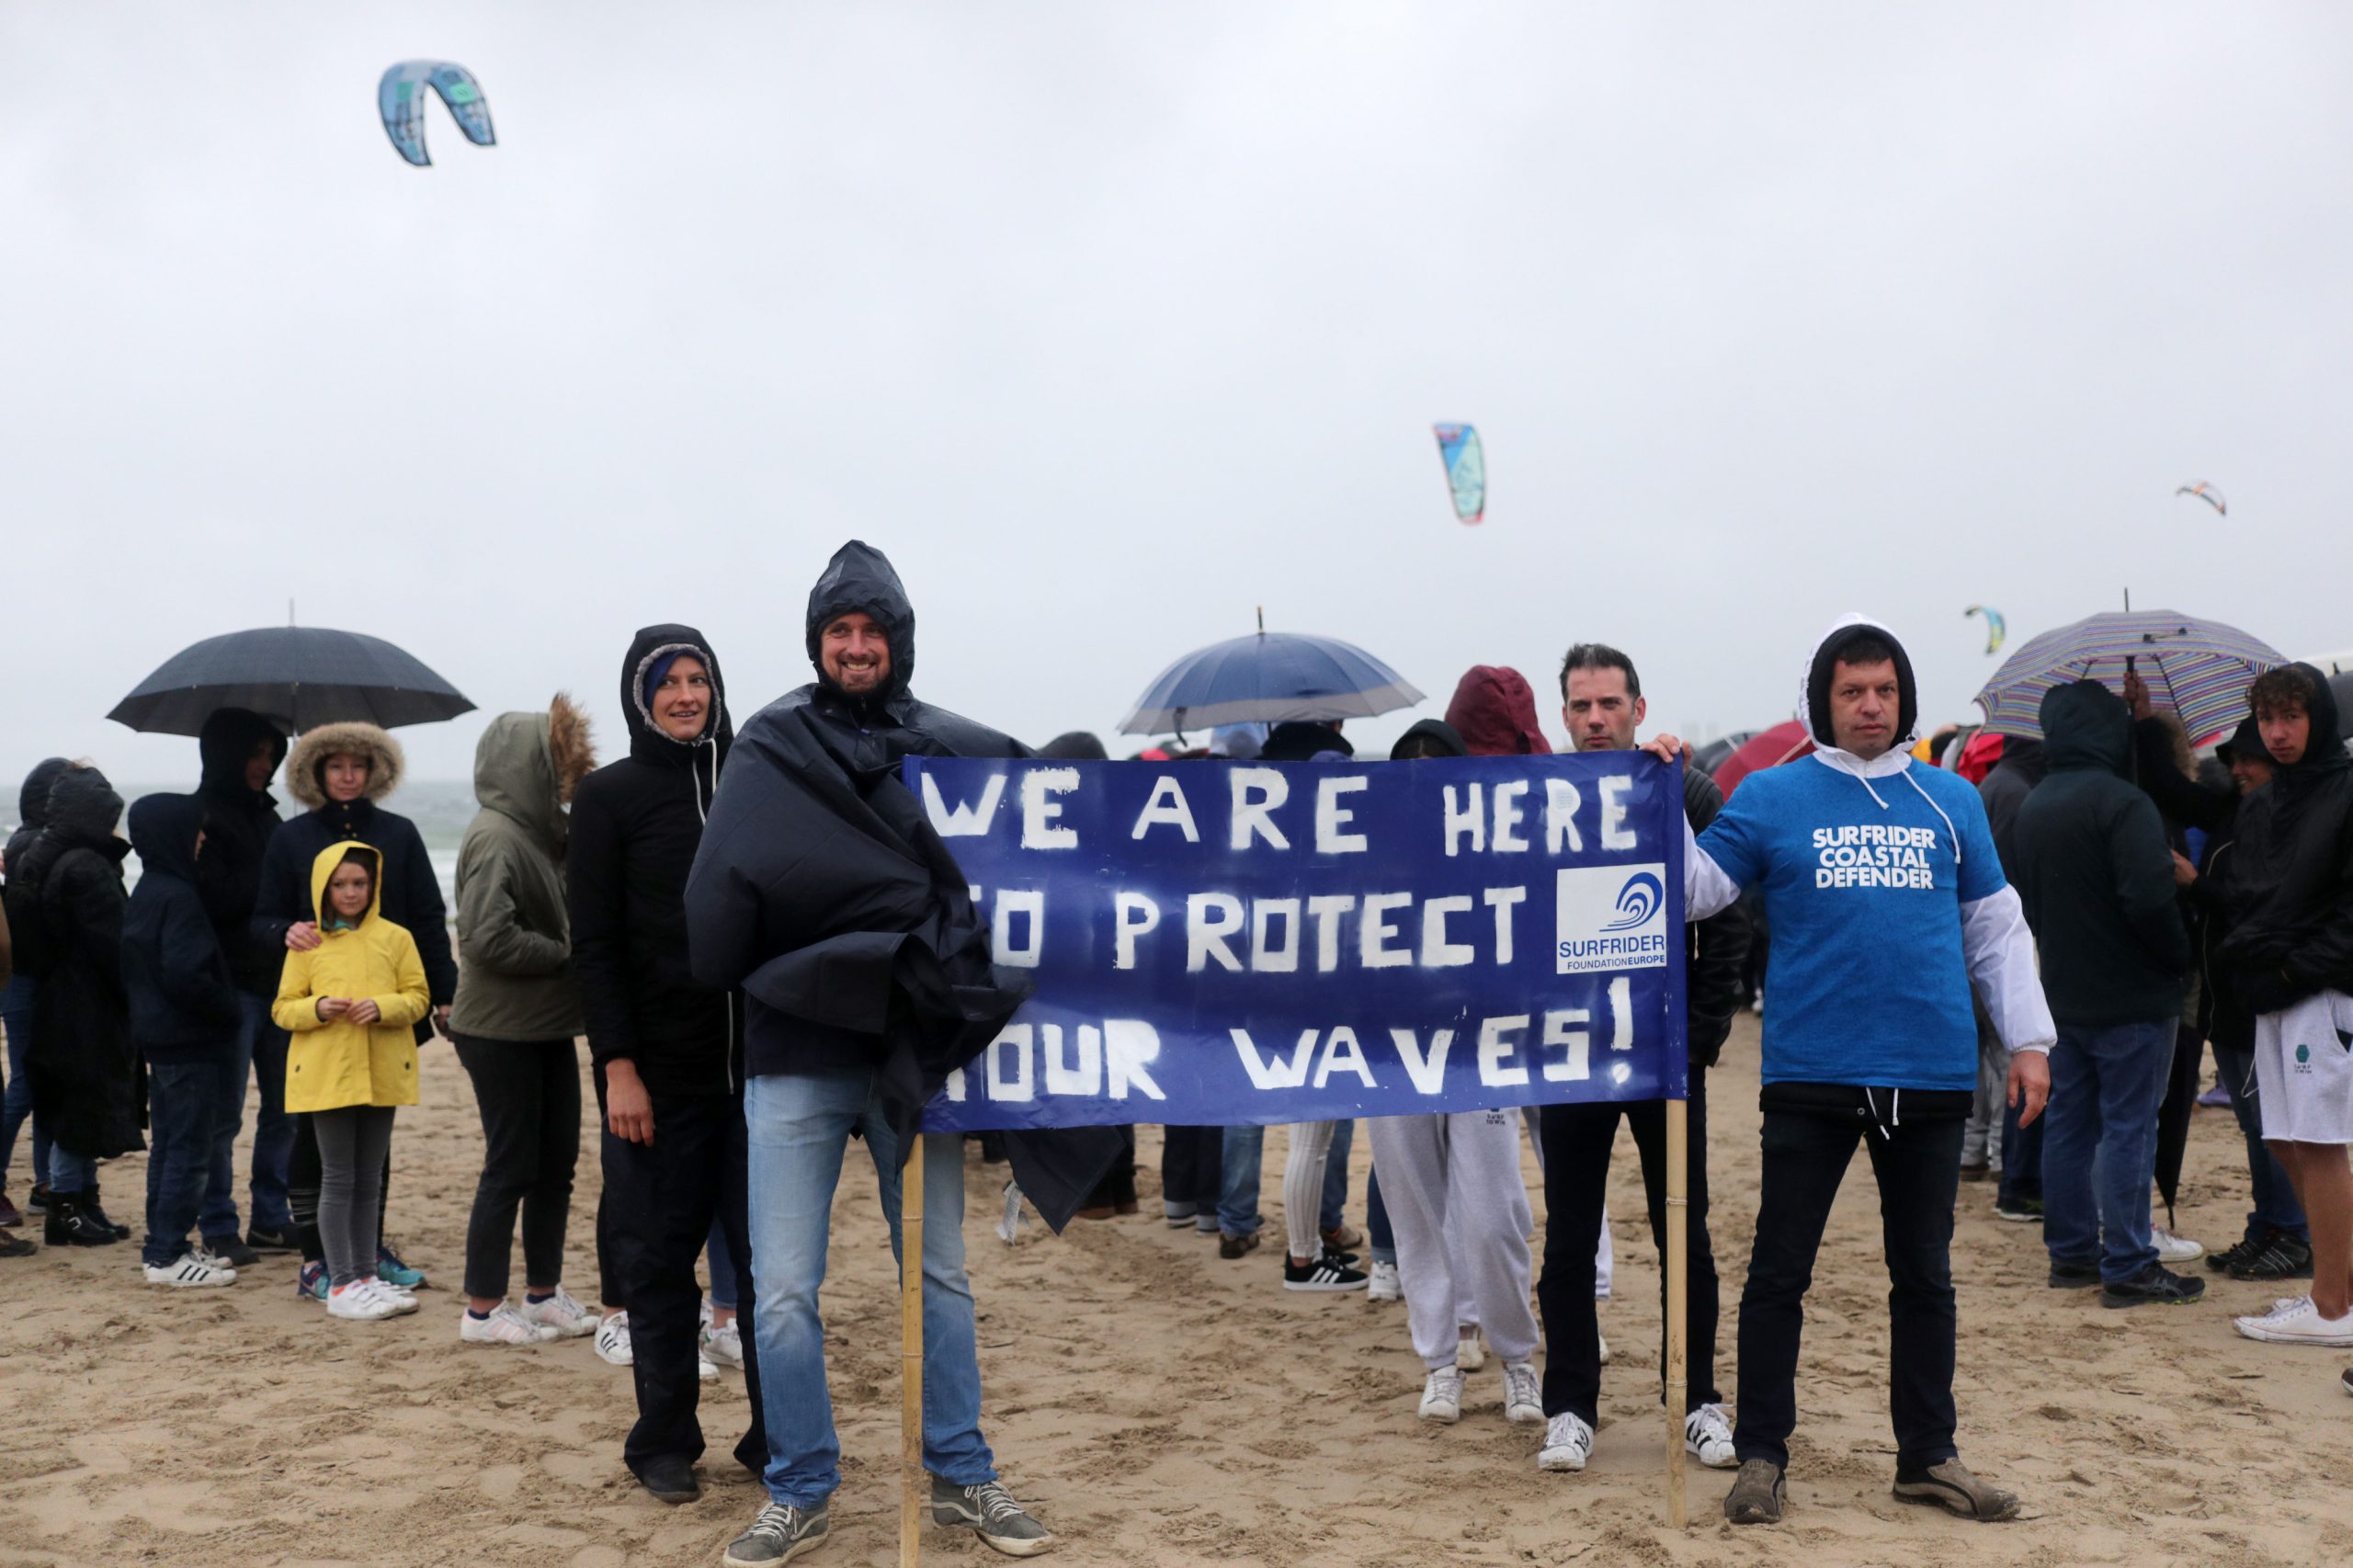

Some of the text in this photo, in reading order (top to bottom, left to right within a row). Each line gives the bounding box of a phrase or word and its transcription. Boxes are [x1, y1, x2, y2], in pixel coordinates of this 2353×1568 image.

[921, 767, 1637, 857] WE ARE HERE
[1813, 825, 1937, 849] SURFRIDER
[1819, 846, 1930, 869] COASTAL
[1815, 867, 1935, 890] DEFENDER
[969, 885, 1527, 971] O PROTECT
[1559, 935, 1665, 958] SURFRIDER
[1229, 977, 1633, 1094] WAVES!
